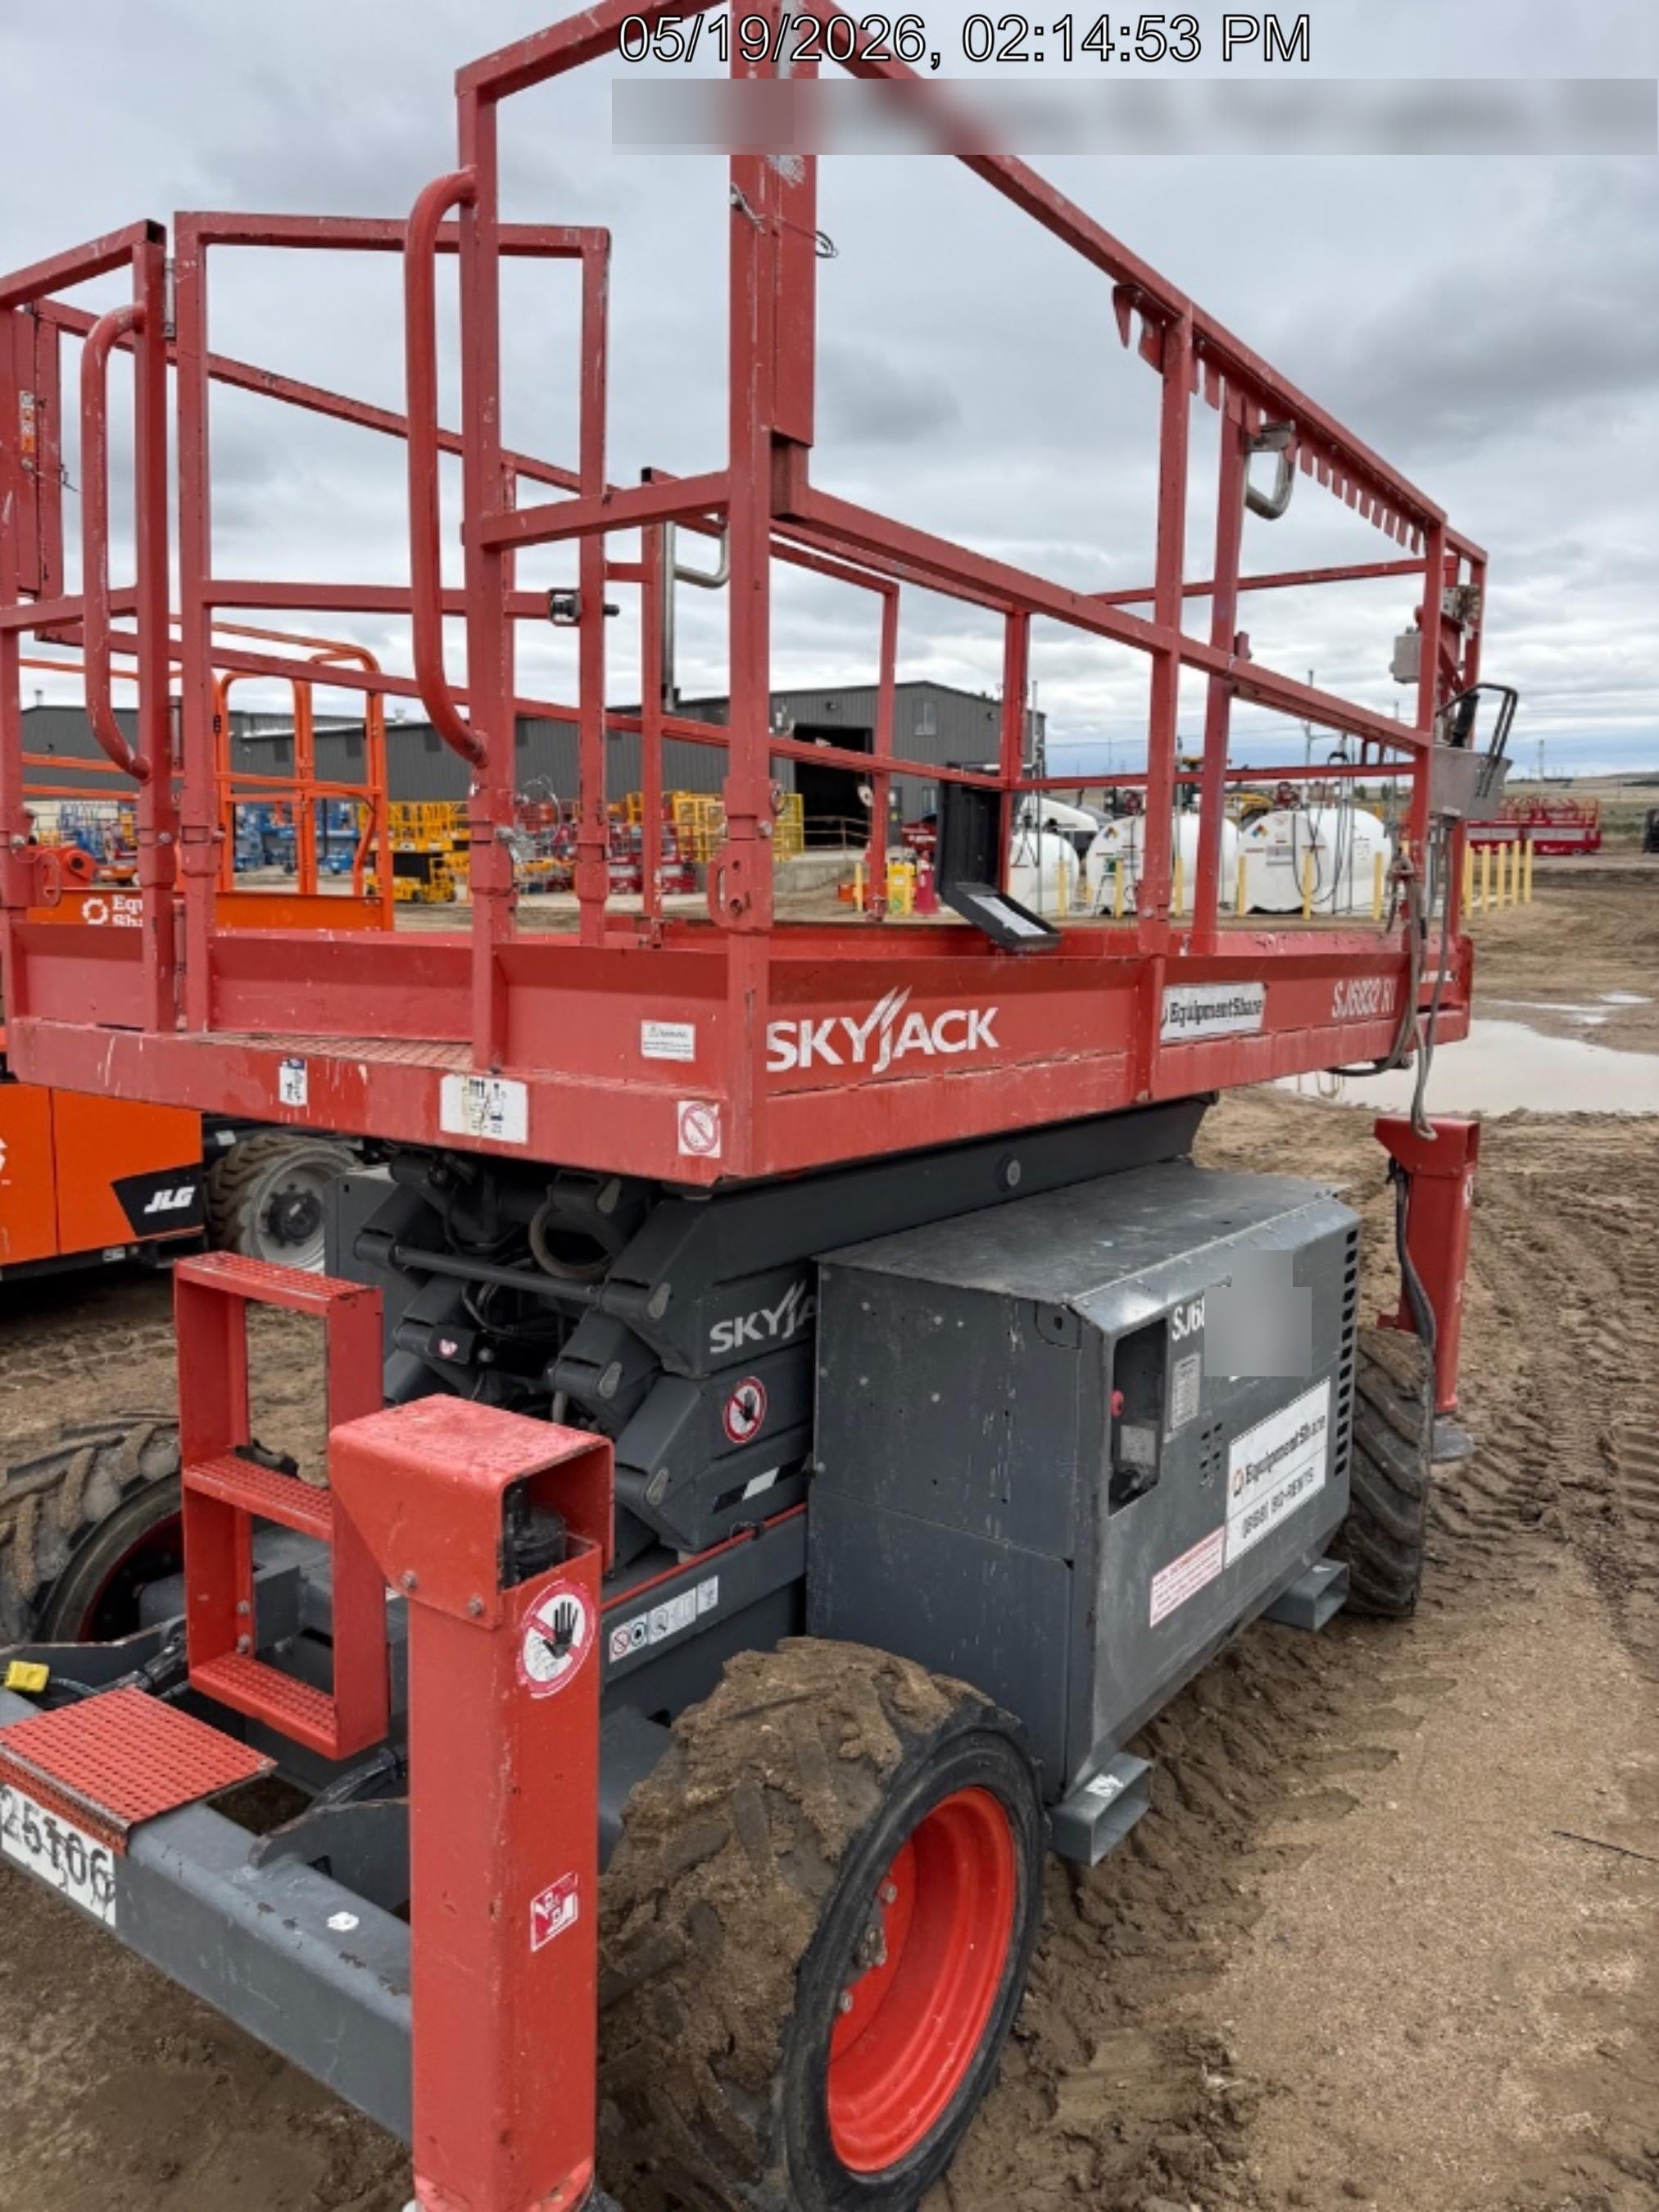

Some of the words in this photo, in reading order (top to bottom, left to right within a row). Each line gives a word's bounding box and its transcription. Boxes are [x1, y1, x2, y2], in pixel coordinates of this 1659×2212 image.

[1170, 996, 1262, 1027] EquipmentShare
[765, 985, 999, 1074] SKYJACK
[144, 1185, 195, 1213] JLG
